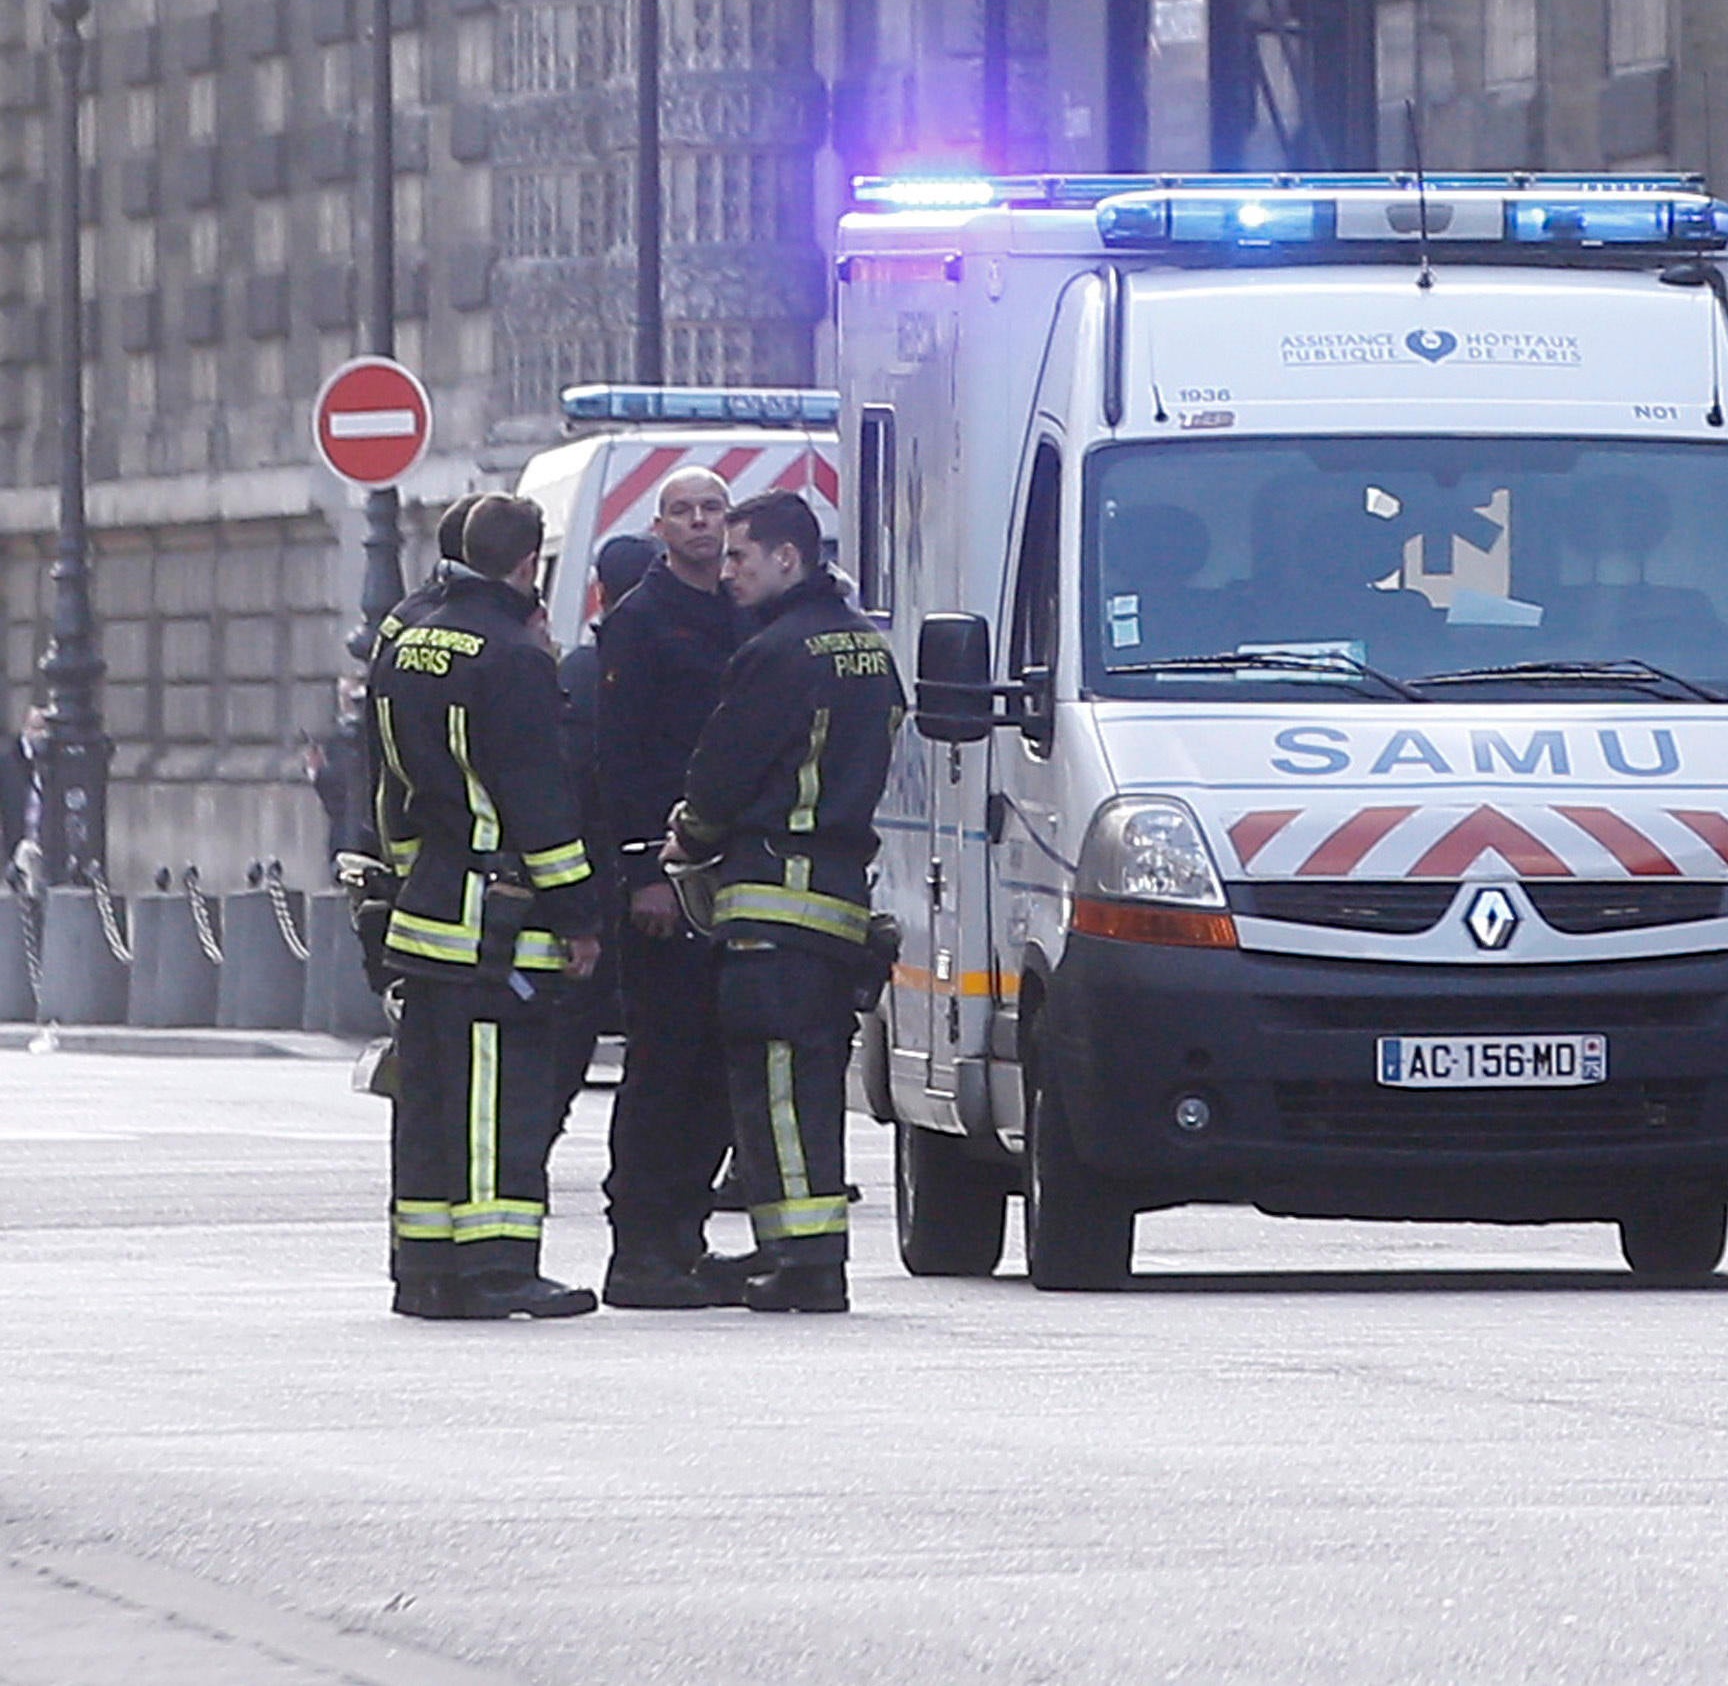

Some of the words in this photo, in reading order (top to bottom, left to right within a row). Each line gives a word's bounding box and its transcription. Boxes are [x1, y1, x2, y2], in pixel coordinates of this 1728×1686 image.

[1281, 334, 1394, 348] ASSISTANCE
[1282, 347, 1399, 363] PUBLIQUE
[1513, 348, 1583, 362] PARIS
[395, 646, 453, 676] PARIS
[835, 650, 889, 679] PARIS
[1270, 725, 1681, 778] SAMU
[1408, 1043, 1576, 1079] AC-156-MD
